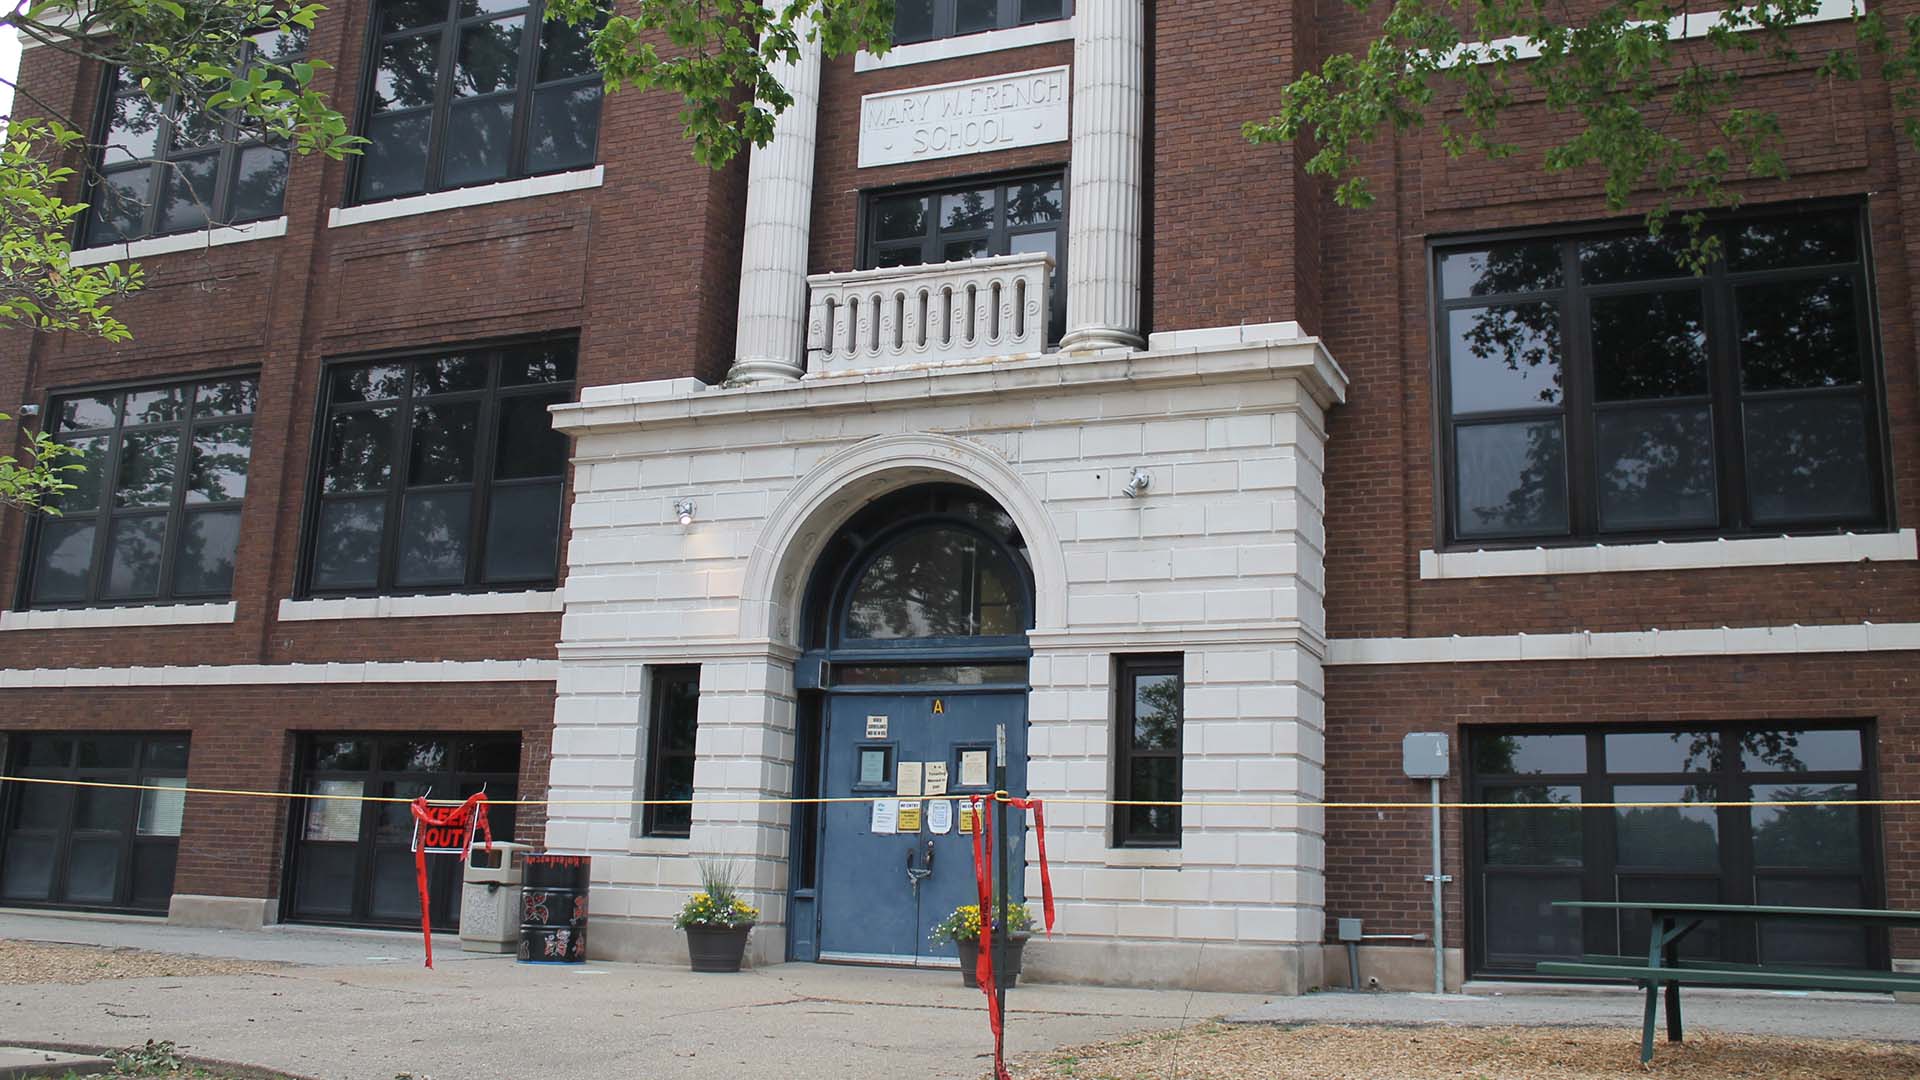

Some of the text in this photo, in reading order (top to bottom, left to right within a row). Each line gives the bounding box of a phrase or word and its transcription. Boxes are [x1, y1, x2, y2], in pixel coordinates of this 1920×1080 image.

[867, 95, 930, 128] MARY
[968, 75, 1063, 114] FRENCH
[912, 116, 1014, 154] SCHOOL
[933, 699, 944, 714] A
[425, 828, 464, 847] OUT
